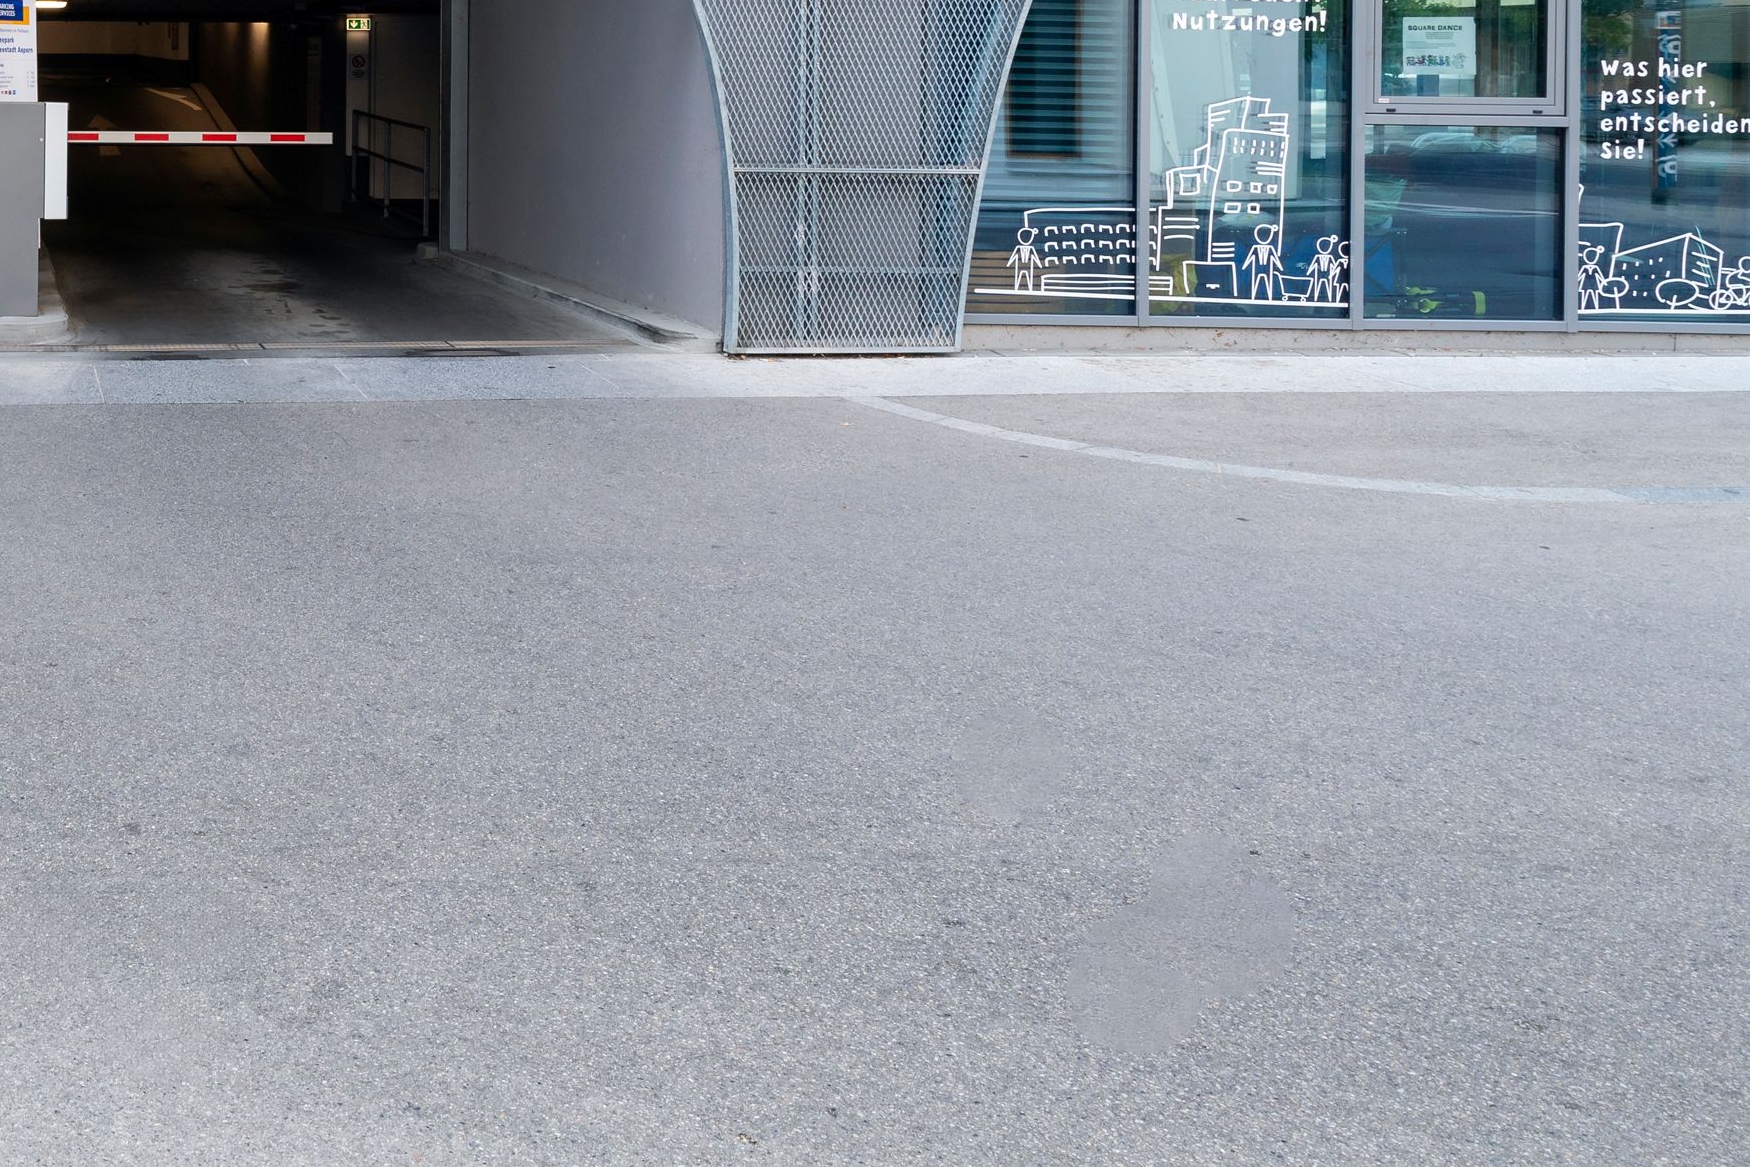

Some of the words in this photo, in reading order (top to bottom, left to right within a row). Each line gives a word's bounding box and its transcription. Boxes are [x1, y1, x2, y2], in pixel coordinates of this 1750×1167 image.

[1172, 9, 1327, 37] Nutzungen!
[1658, 57, 1708, 78] hier
[1600, 85, 1716, 111] passiert,
[1600, 112, 1750, 134] entscheiden
[1600, 138, 1645, 160] Sie!
